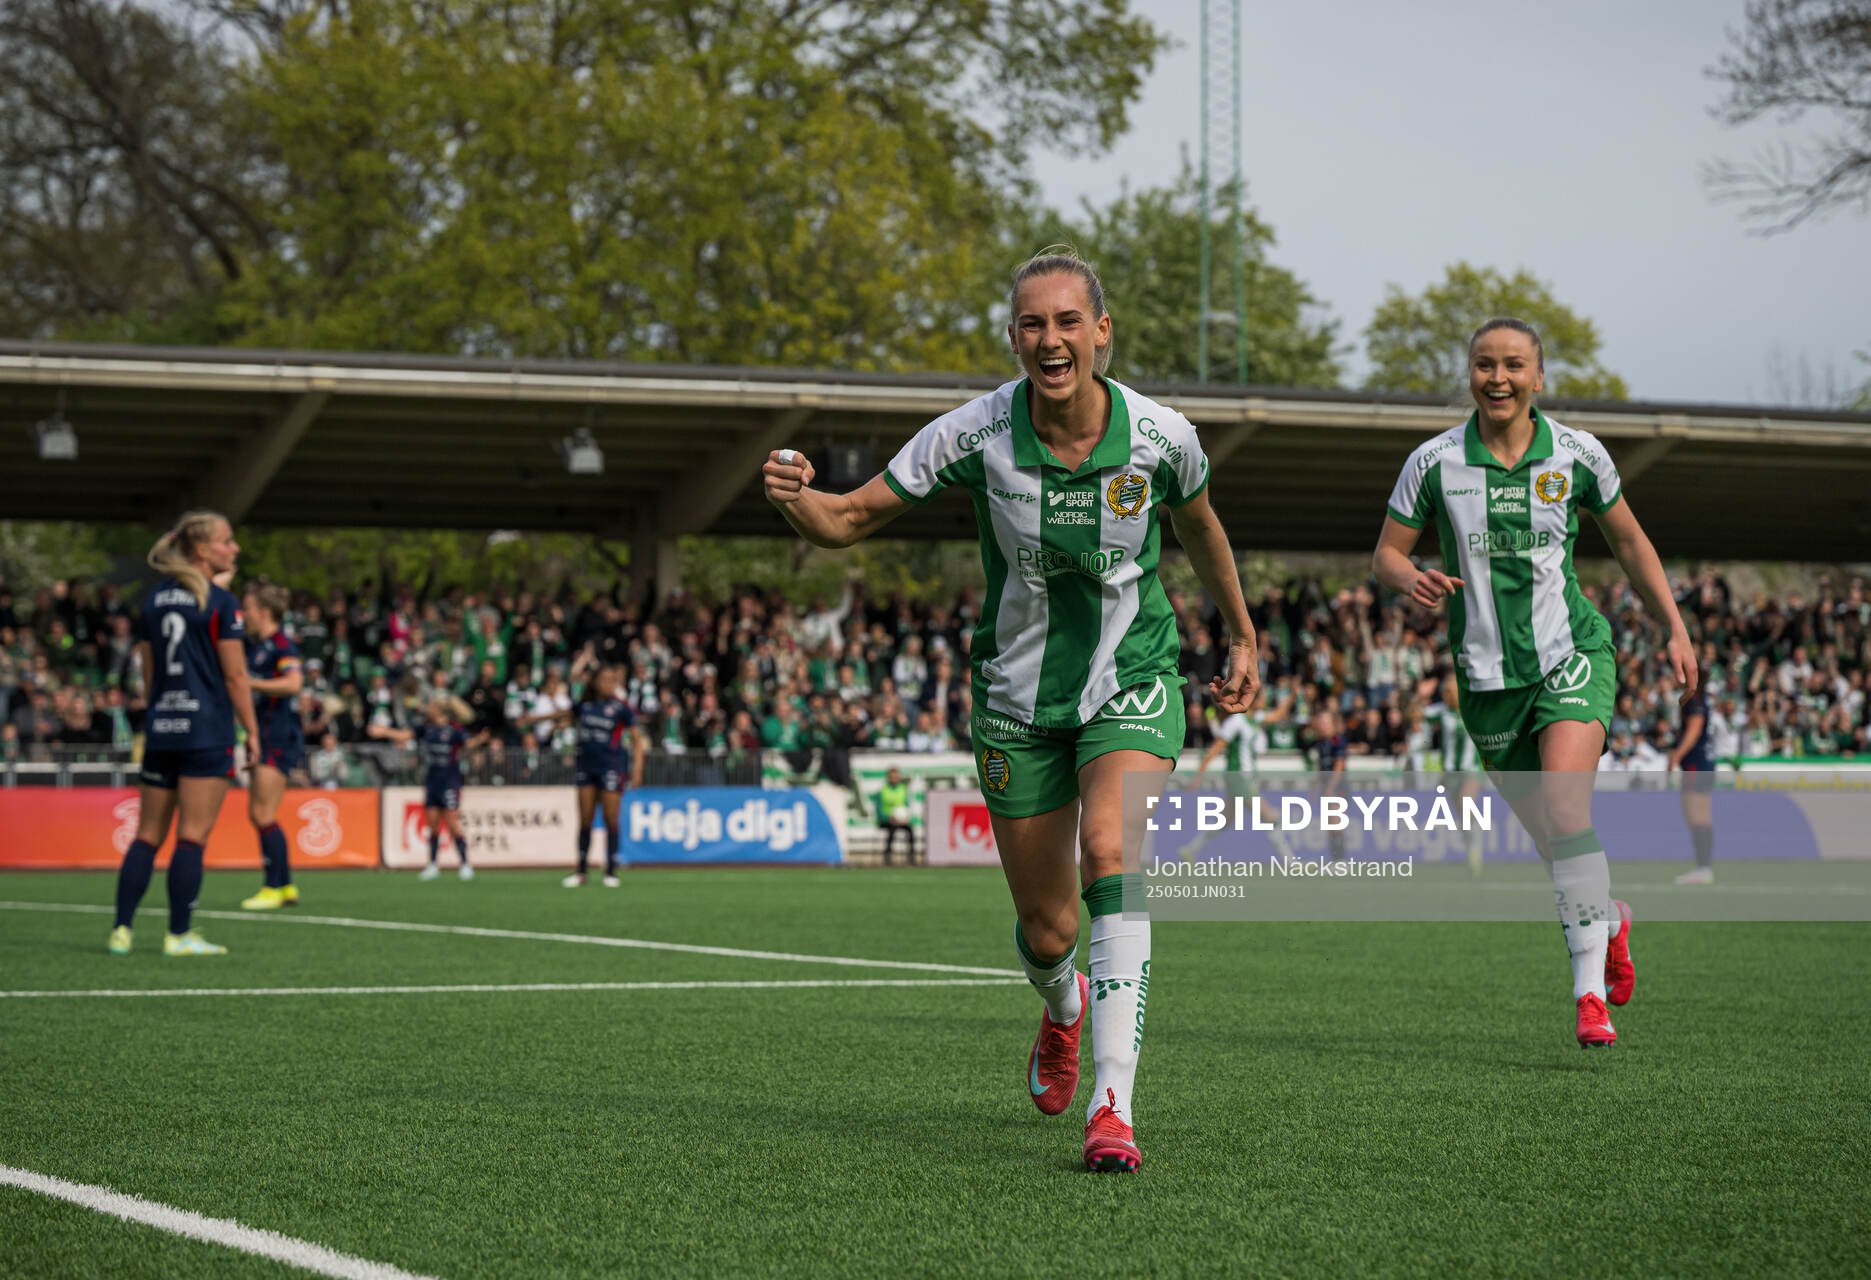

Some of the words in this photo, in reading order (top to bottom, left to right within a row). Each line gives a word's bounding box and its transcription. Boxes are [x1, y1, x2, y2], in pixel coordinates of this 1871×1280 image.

[957, 411, 1012, 451] Convini
[1137, 417, 1188, 466] Convini
[1558, 433, 1601, 468] Convini
[1416, 436, 1457, 471] Convini
[992, 488, 1026, 503] CRAFT
[1065, 491, 1094, 500] INTER
[1446, 488, 1474, 496] CRAFT
[1065, 499, 1094, 507] SPORT
[1046, 517, 1096, 526] WELLNESS
[1054, 511, 1088, 519] NORDIC
[1468, 530, 1551, 551] PROJOB
[161, 612, 187, 676] 2
[1120, 723, 1157, 735] CRAFT
[297, 797, 343, 857] 3
[629, 799, 722, 851] Heja
[726, 799, 808, 851] dig!
[472, 834, 512, 850] PEL
